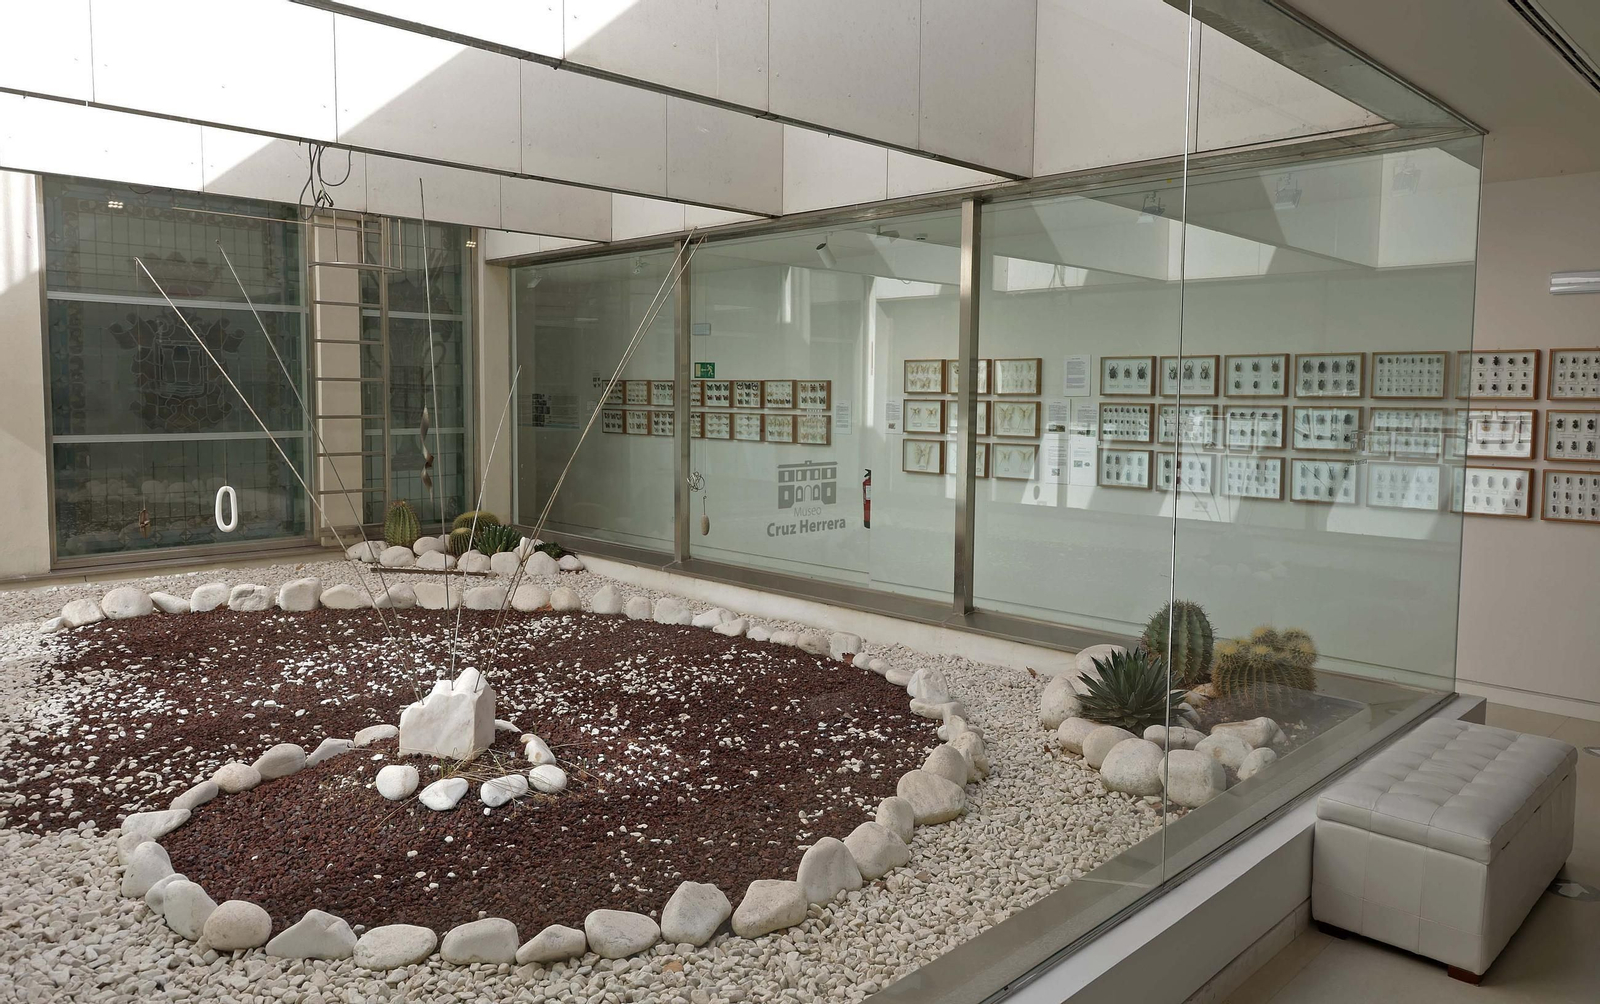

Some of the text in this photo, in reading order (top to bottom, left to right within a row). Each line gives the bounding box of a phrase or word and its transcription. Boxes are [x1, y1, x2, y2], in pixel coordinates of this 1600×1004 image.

[794, 506, 822, 517] Museo
[766, 518, 846, 537] Cruz Herrera
